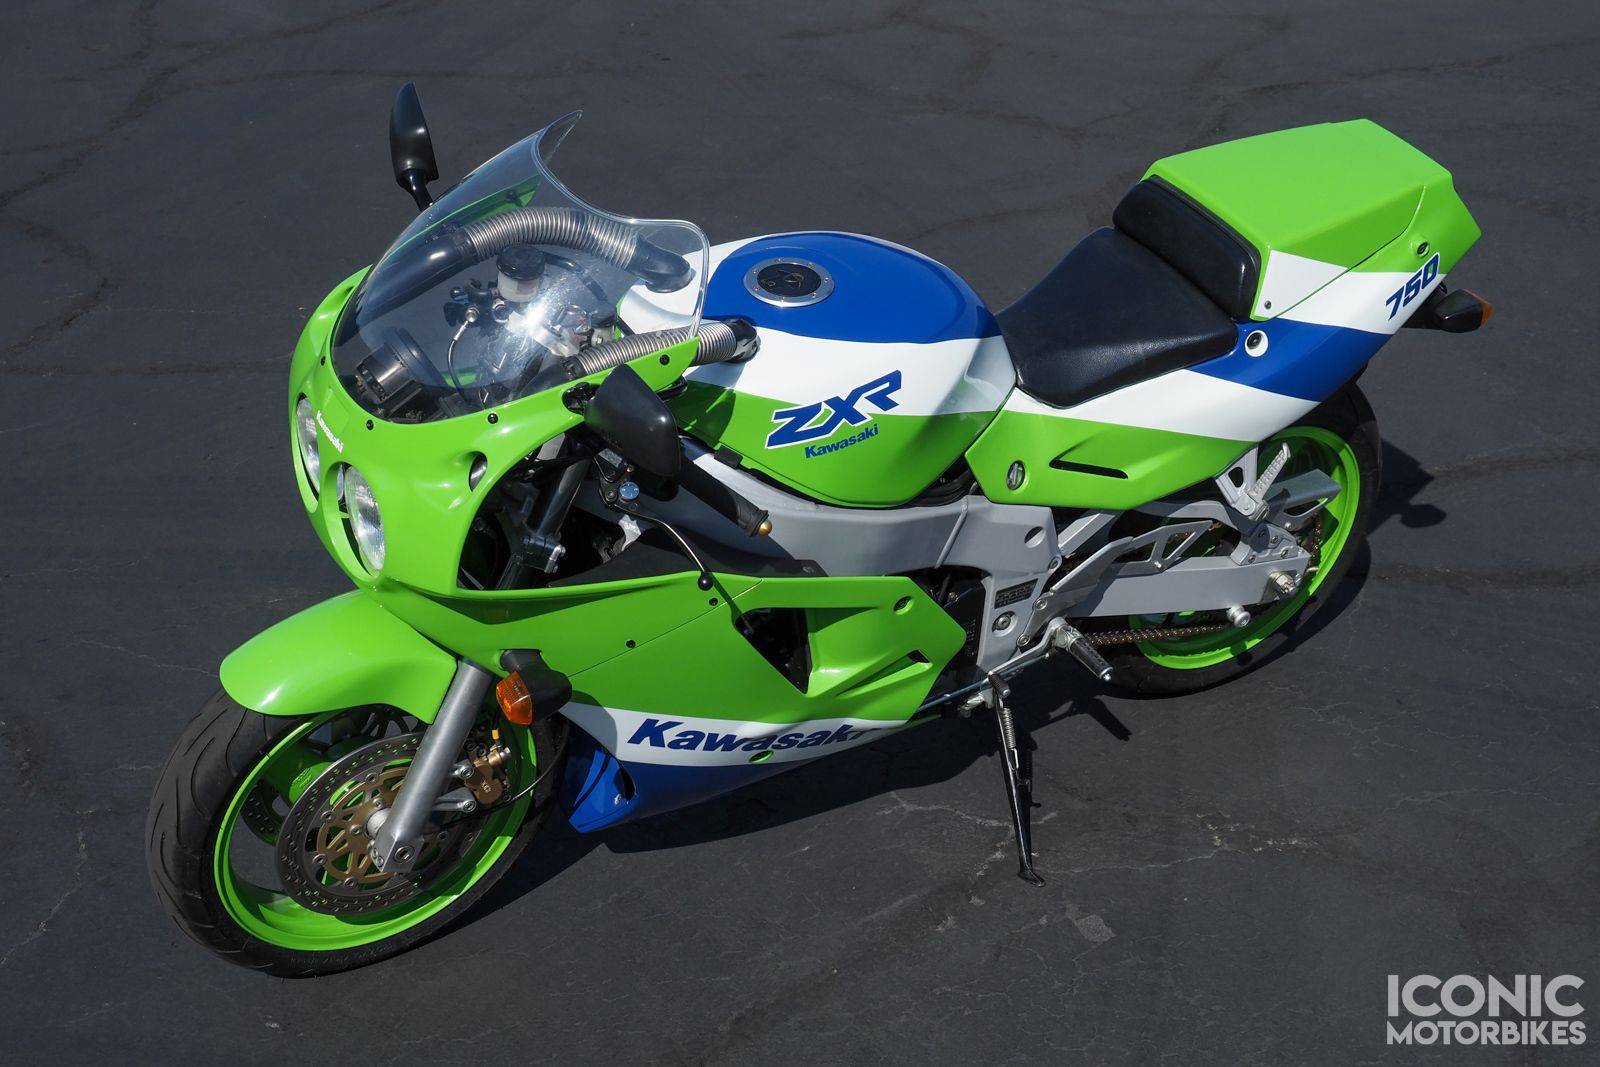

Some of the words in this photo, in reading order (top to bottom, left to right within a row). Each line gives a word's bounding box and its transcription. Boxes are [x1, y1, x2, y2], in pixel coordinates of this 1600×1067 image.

[1386, 253, 1439, 320] 750
[766, 369, 902, 448] ZXR
[805, 424, 879, 458] Kawasaki
[628, 718, 882, 752] Kawasaki
